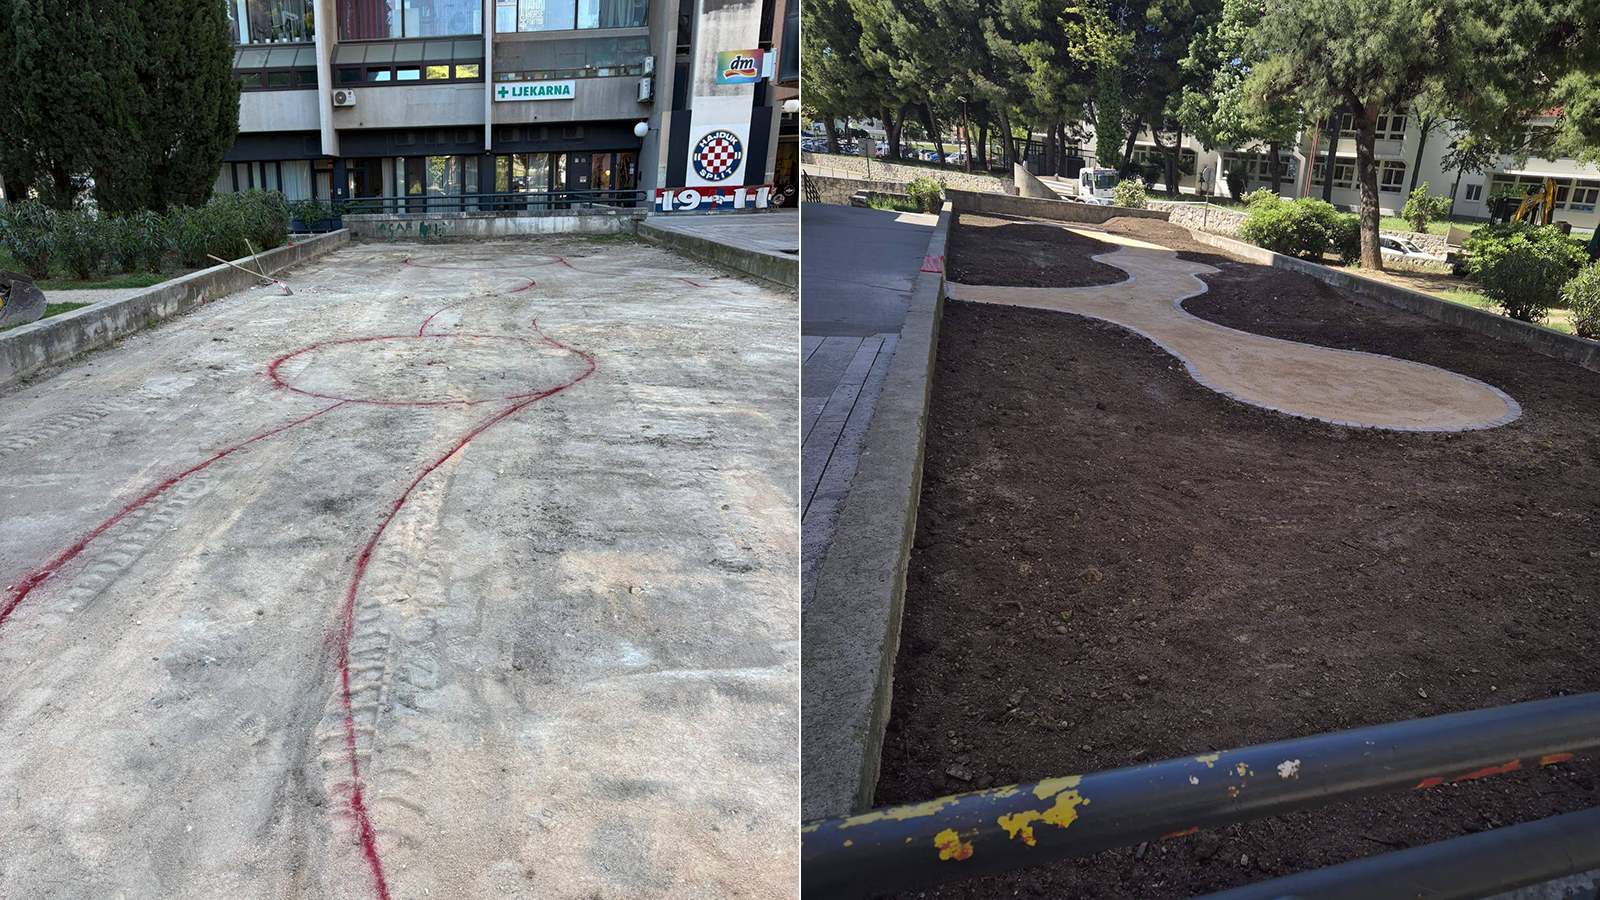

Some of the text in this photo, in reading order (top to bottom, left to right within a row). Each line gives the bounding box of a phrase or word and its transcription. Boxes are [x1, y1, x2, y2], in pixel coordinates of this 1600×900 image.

[730, 56, 754, 70] dm
[512, 85, 570, 97] LJEKARNA
[699, 131, 738, 148] HAJDUK
[699, 168, 732, 180] SPLIT
